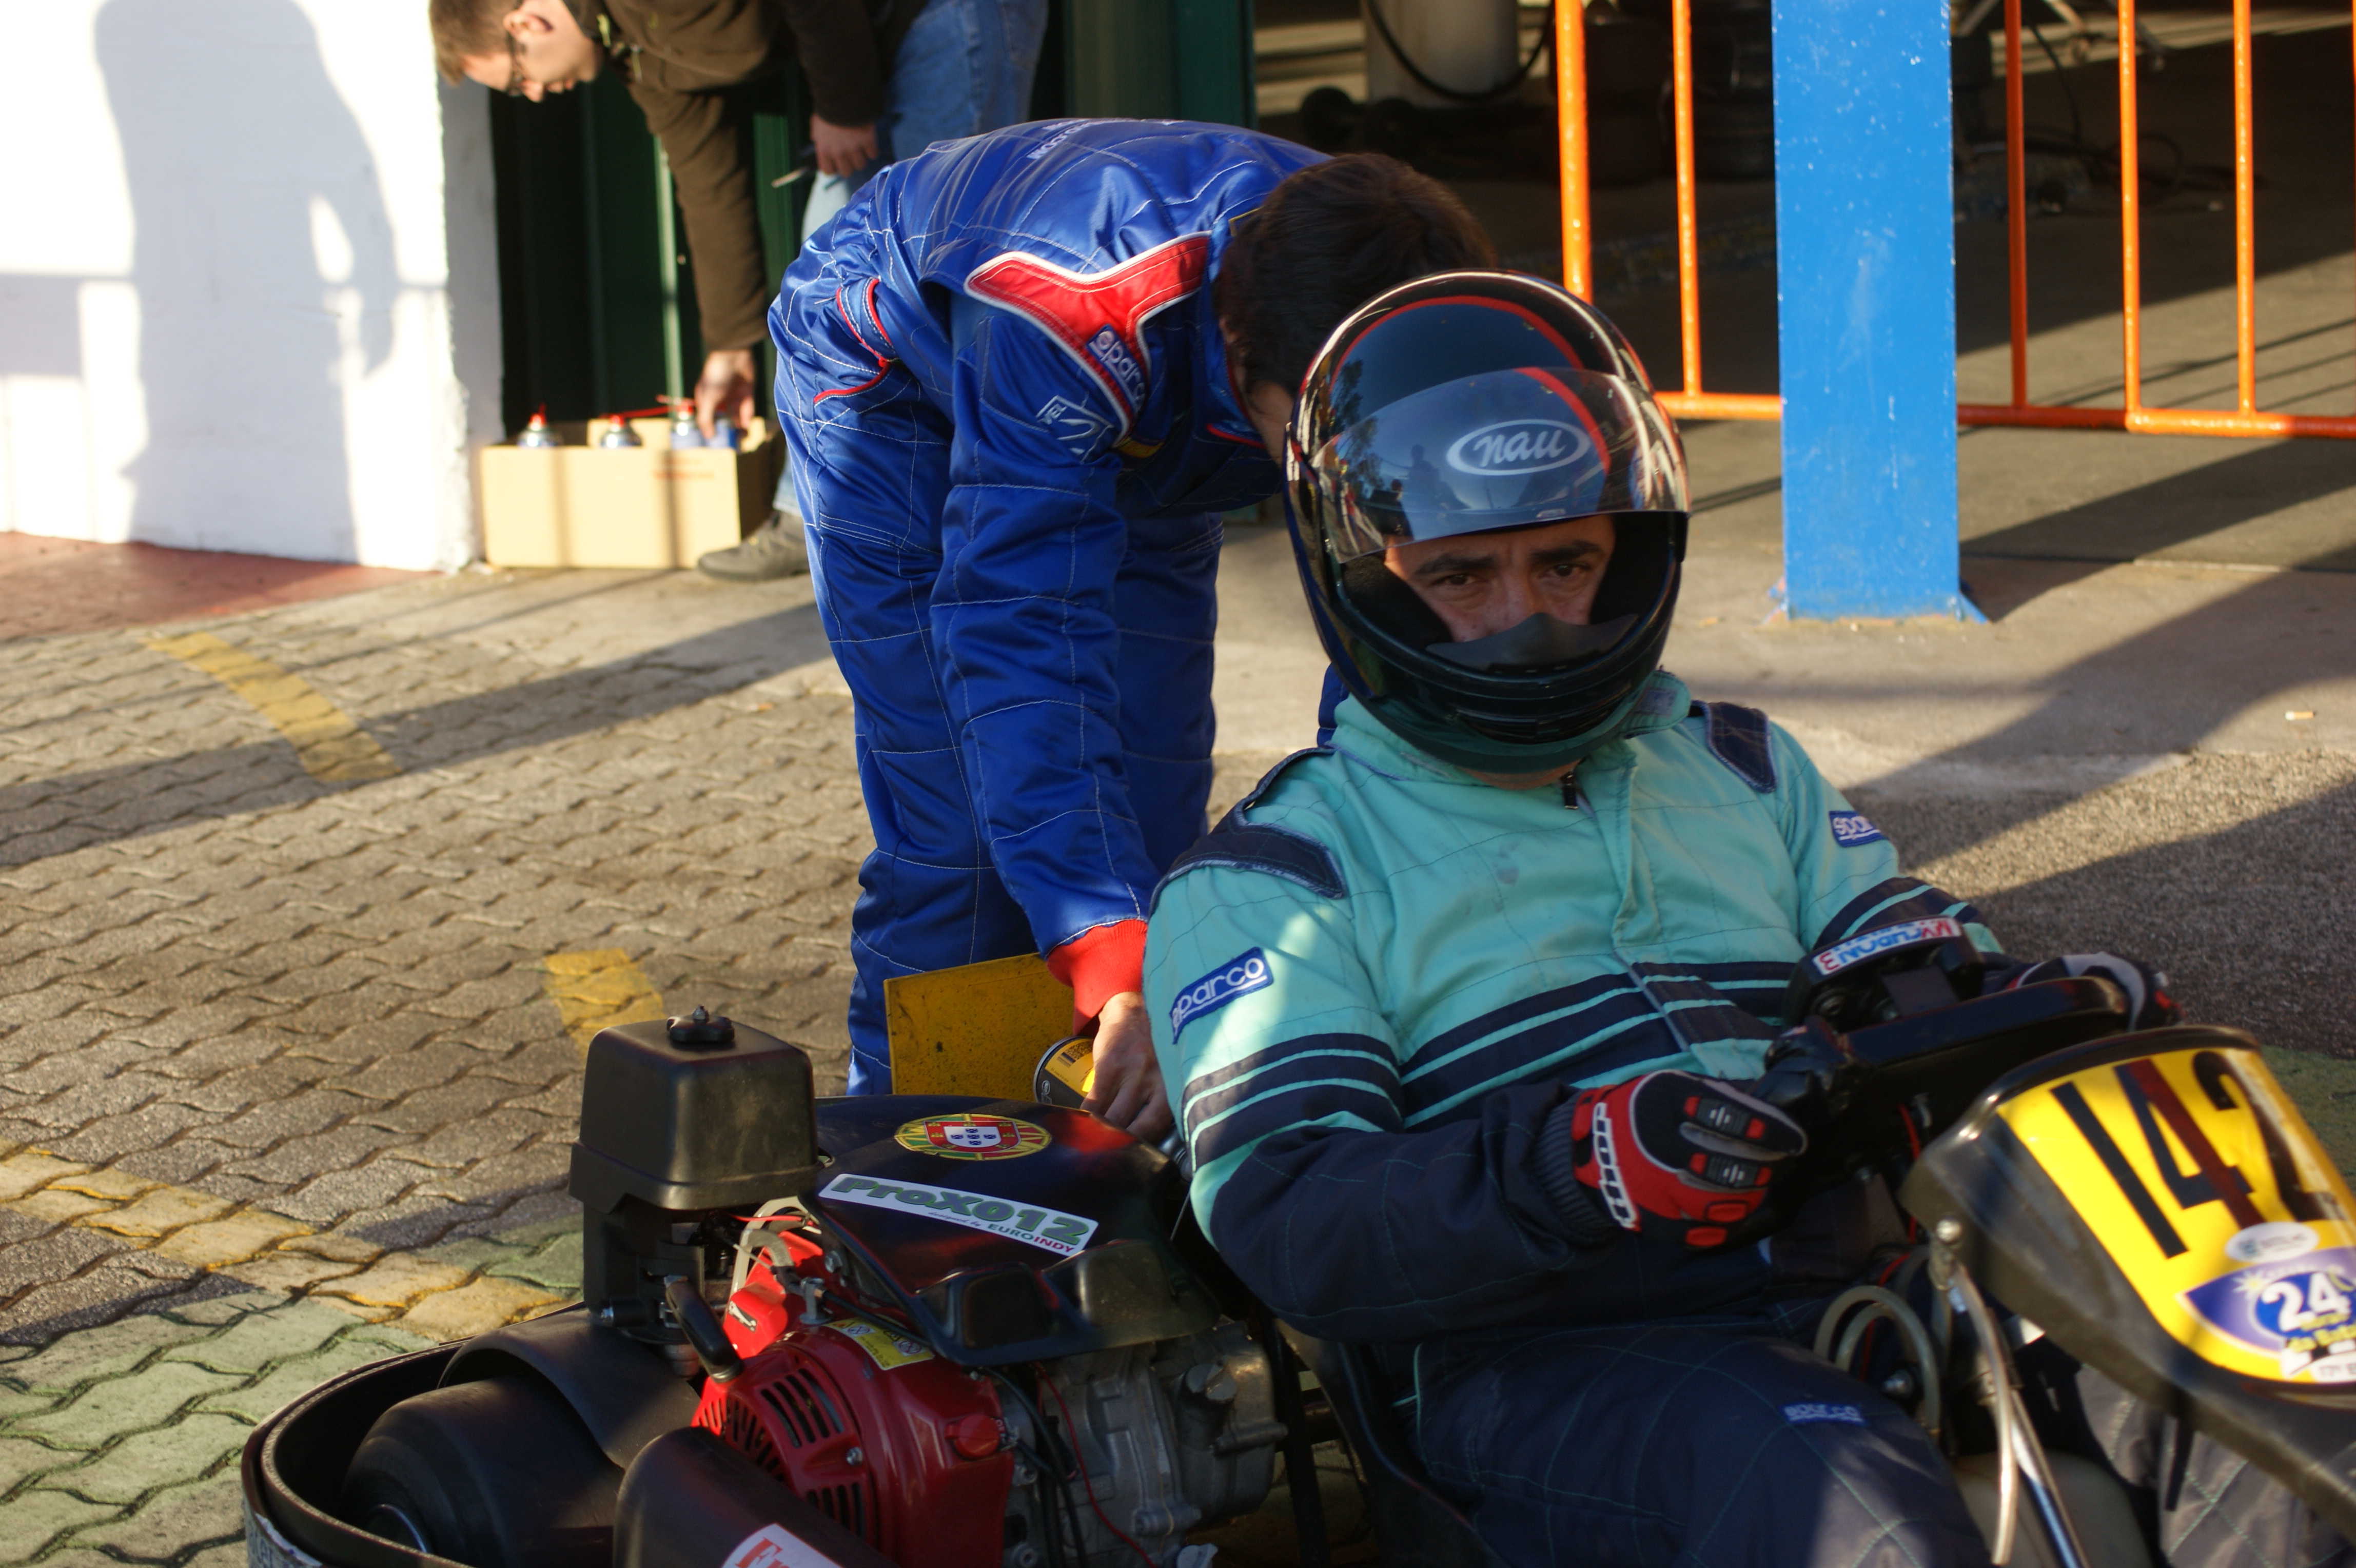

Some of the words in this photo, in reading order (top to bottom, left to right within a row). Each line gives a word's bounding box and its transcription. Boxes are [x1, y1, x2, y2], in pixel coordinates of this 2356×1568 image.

[1473, 429, 1566, 467] nau
[1172, 957, 1265, 1031] sparco
[2049, 1051, 2346, 1260] 142
[831, 1177, 1089, 1245] ProX012
[928, 1211, 969, 1223] designed
[988, 1223, 1075, 1253] EUROINDY
[2260, 1272, 2351, 1332] 24
